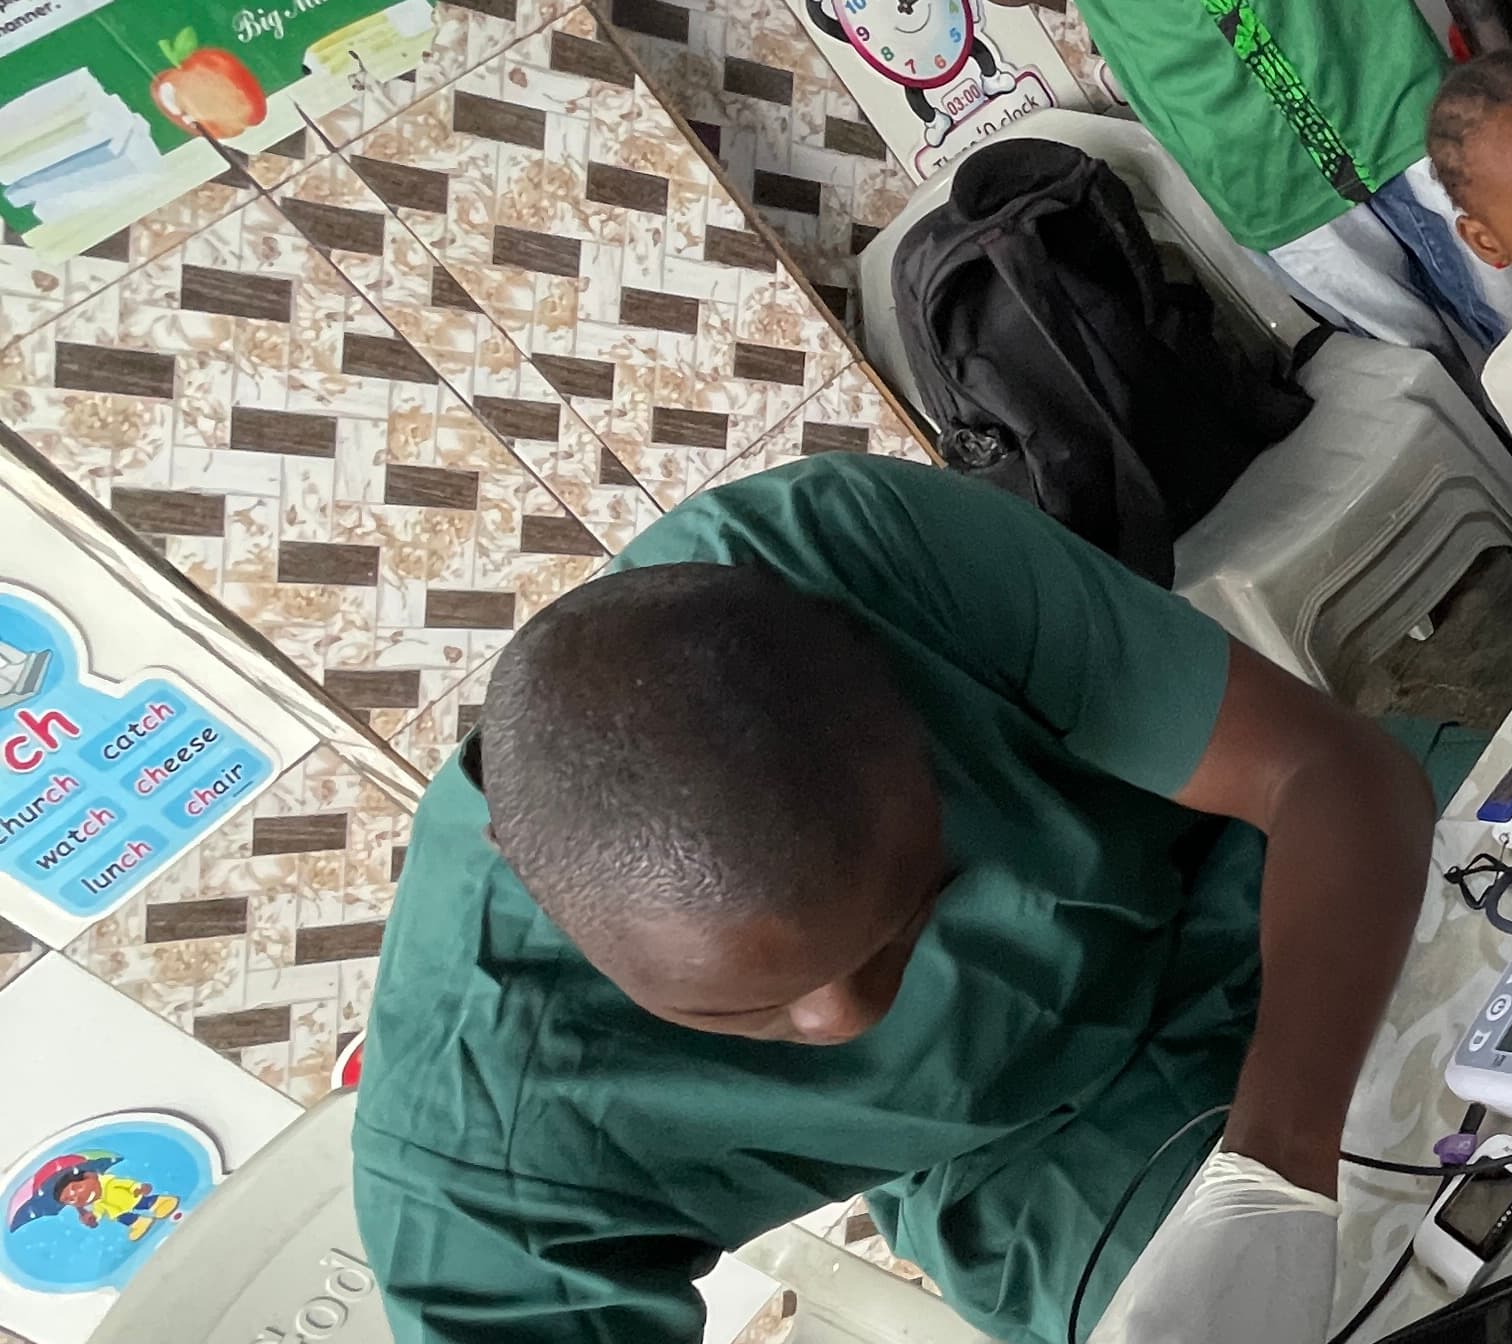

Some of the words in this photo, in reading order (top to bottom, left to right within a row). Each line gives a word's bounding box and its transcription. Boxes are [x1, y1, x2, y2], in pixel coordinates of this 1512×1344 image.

[232, 9, 284, 43] Big
[856, 26, 870, 42] 9
[950, 28, 962, 44] 5
[880, 46, 894, 61] 8
[904, 59, 917, 74] 7
[934, 54, 947, 69] 6
[946, 84, 982, 116] 03:00
[4, 710, 81, 773] ch
[103, 702, 174, 760] catch
[137, 726, 218, 796] cheese
[186, 761, 243, 817] chair
[36, 807, 116, 870] watch
[80, 839, 153, 895] lunch
